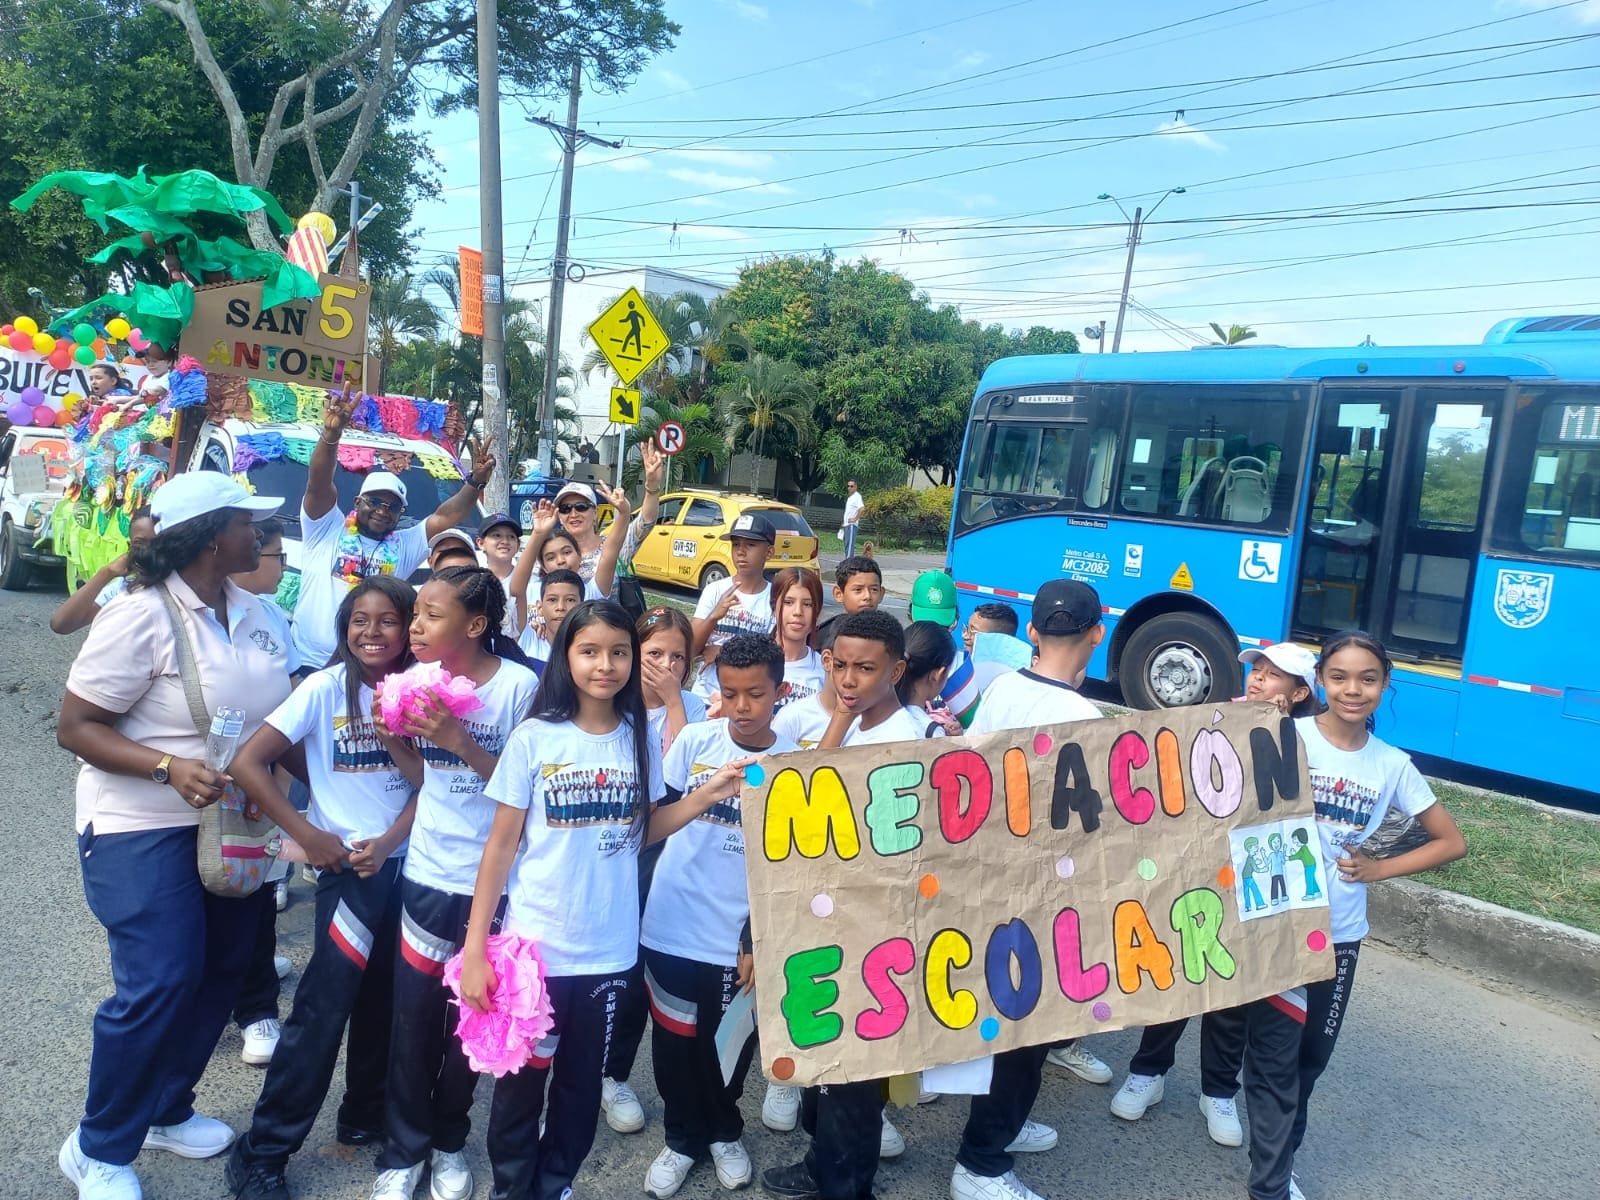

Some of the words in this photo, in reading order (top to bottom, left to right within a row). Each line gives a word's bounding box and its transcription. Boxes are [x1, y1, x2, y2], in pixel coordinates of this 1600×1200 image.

[226, 299, 307, 336] SAN
[207, 338, 363, 386] ANTONIO
[673, 541, 697, 553] GVR-521
[1083, 550, 1095, 558] Cali
[1062, 559, 1110, 575] MC32082
[449, 785, 479, 794] LIMEC
[764, 709, 1300, 862] MEDIACIÓN
[598, 841, 628, 851] LIMEC
[780, 887, 1236, 1049] ESCOLAR
[1323, 958, 1349, 1037] EMPERADOR
